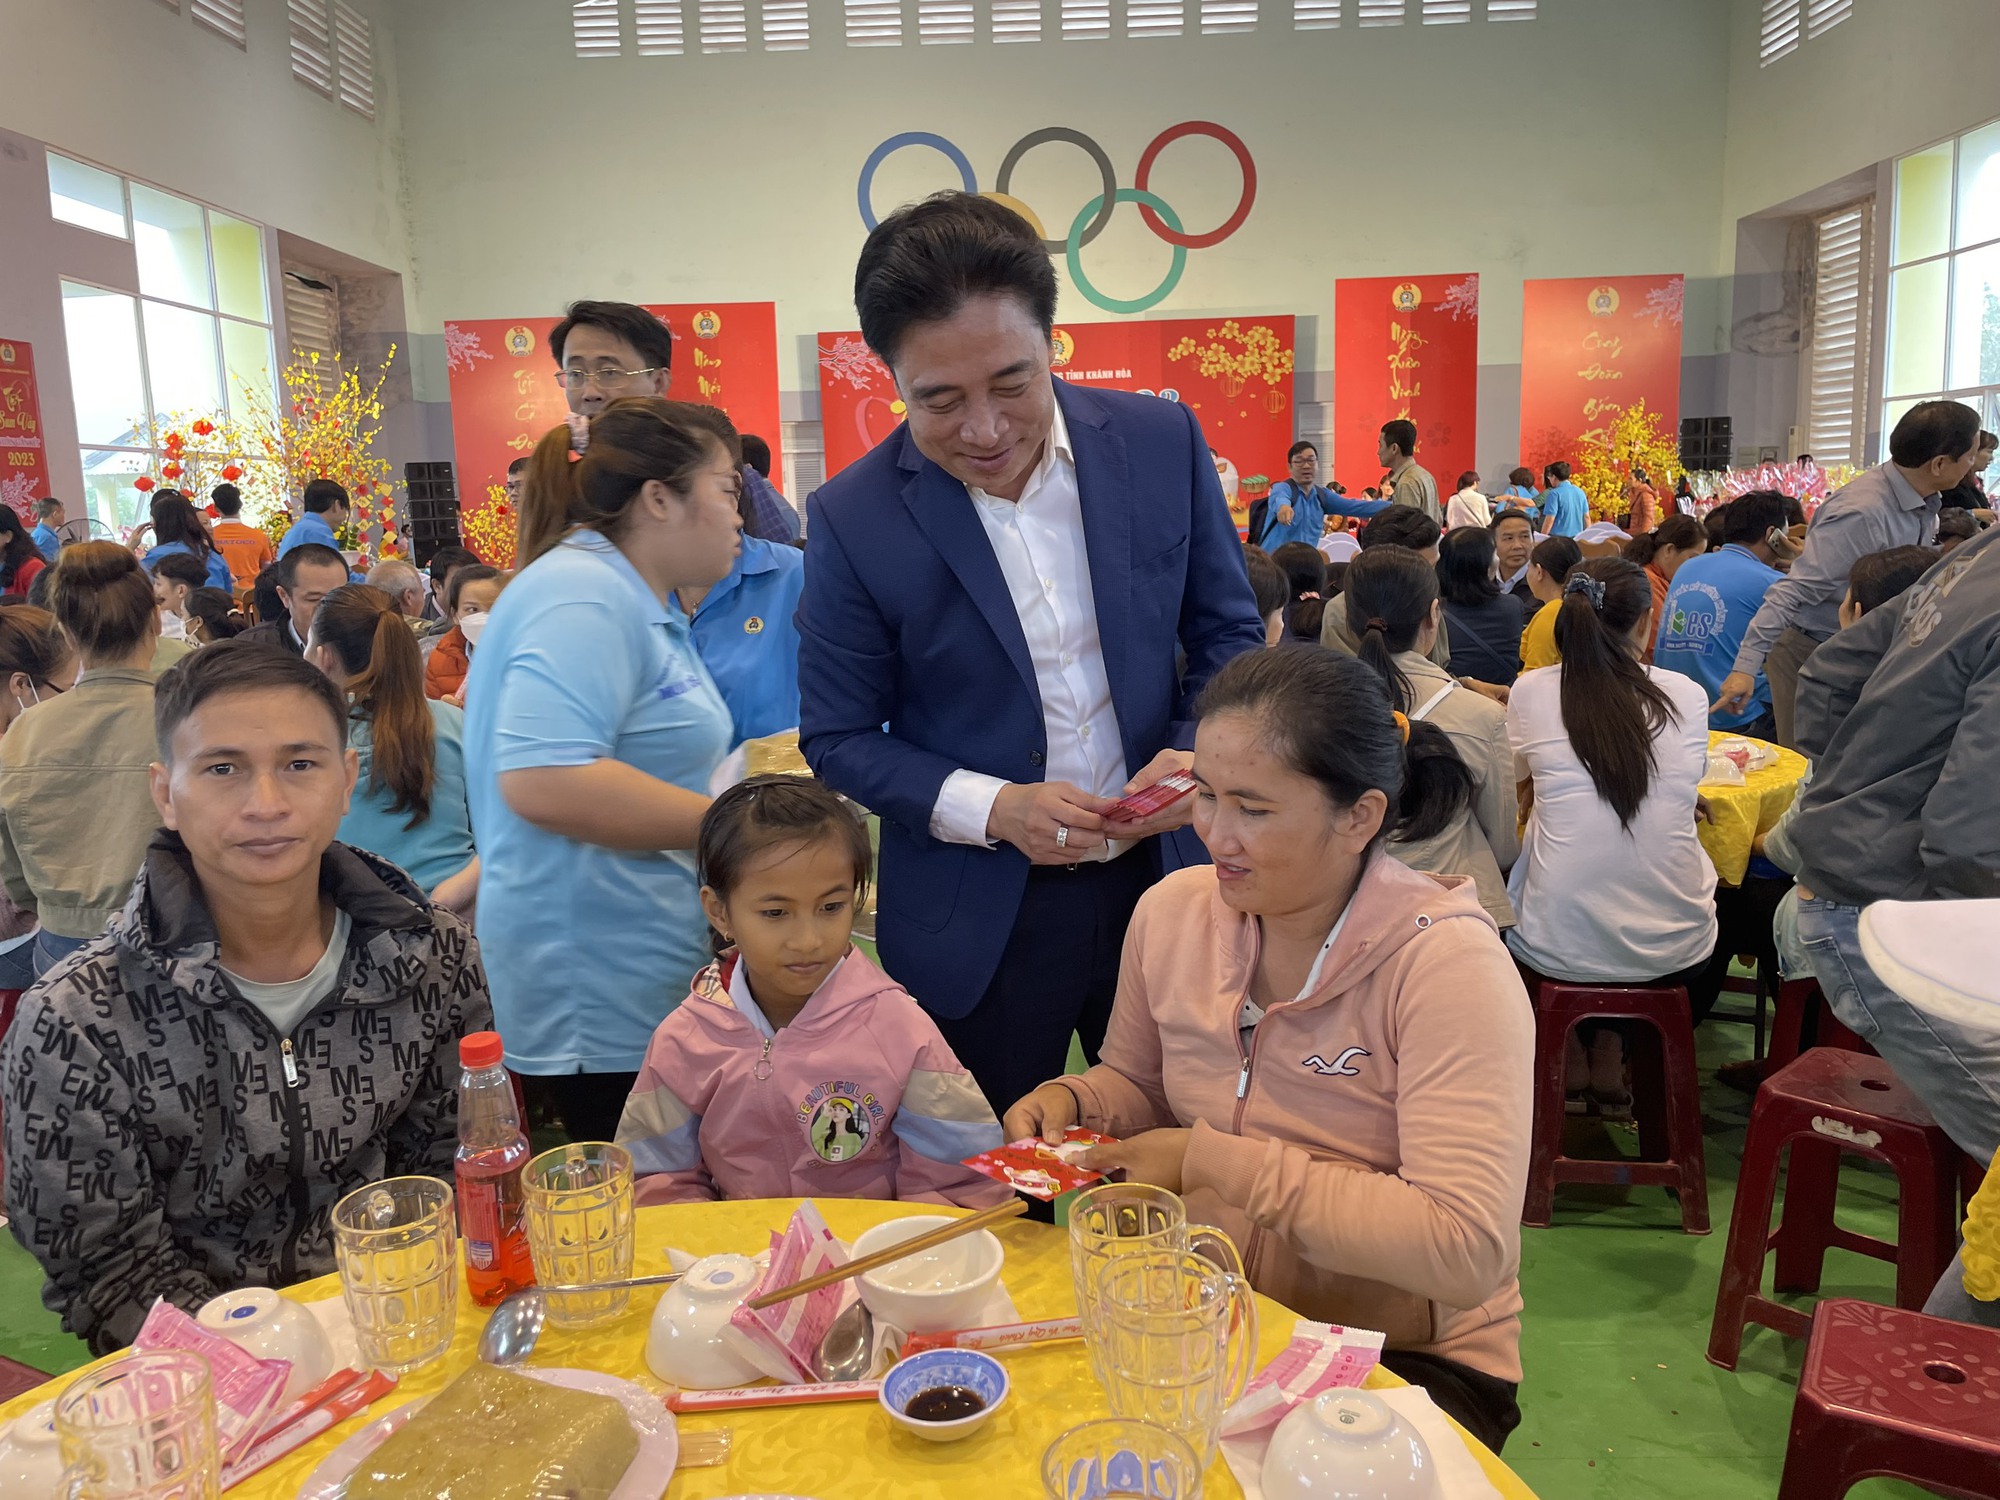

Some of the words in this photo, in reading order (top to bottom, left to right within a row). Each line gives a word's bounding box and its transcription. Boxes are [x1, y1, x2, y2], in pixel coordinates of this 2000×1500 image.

[1086, 369, 1113, 379] KHÁNH
[8, 451, 36, 467] 2023
[796, 1080, 861, 1124] BEAUTIFUL
[862, 1092, 886, 1125] GIRL
